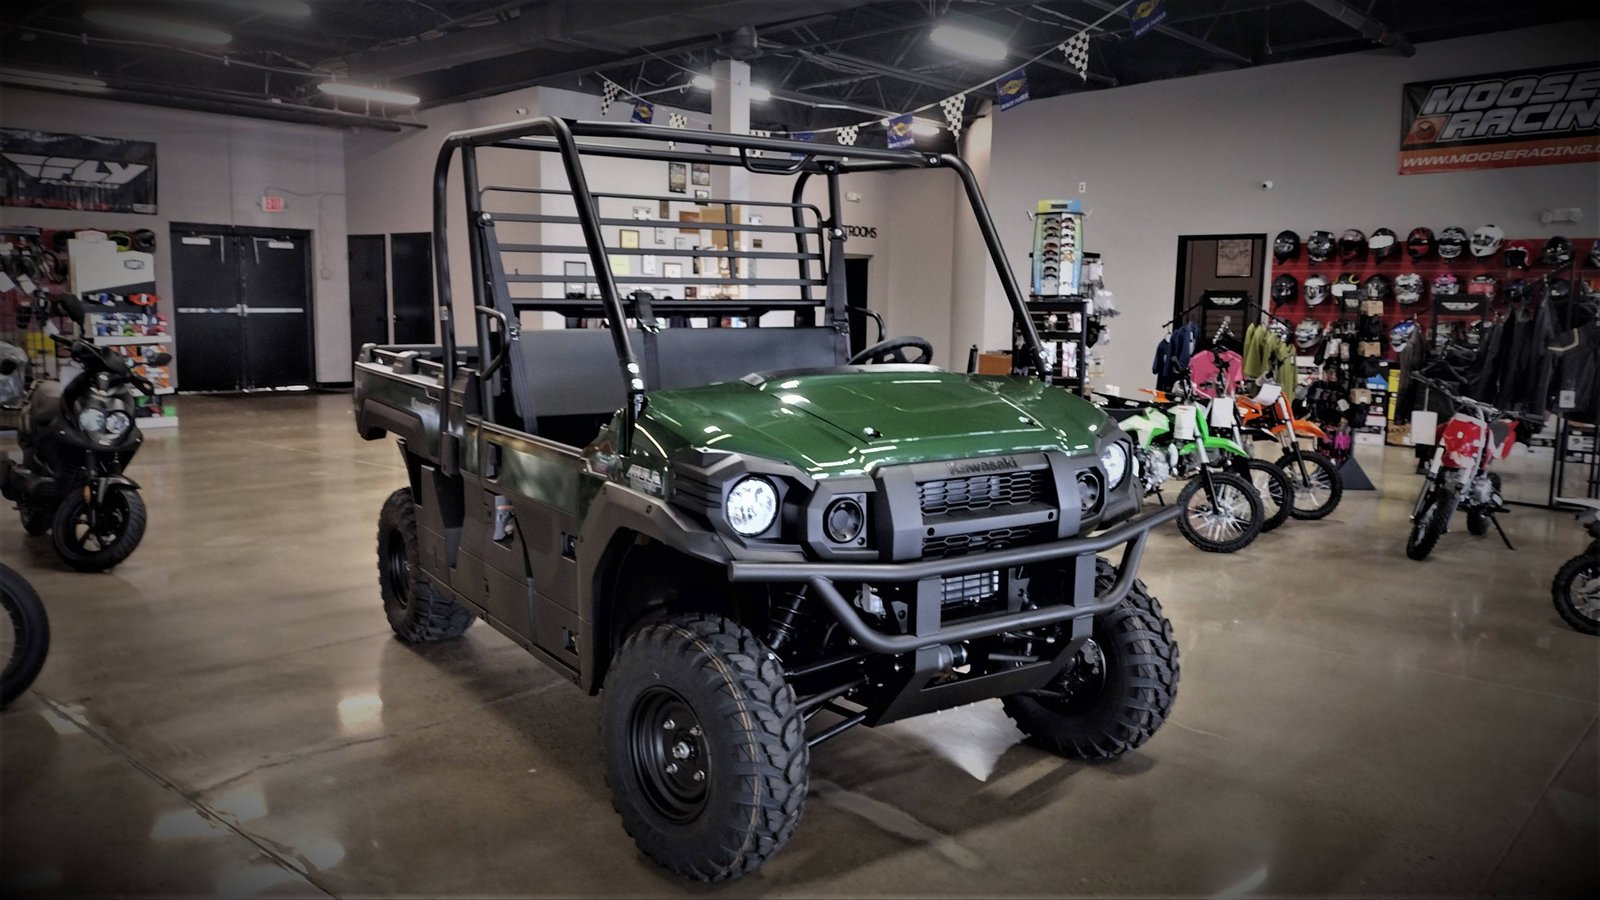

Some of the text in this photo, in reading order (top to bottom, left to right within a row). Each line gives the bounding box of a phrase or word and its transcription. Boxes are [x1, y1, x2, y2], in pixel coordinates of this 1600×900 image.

[1420, 71, 1600, 115] MOOSE
[1438, 99, 1600, 140] RACIN
[945, 456, 1018, 475] Kawasaki
